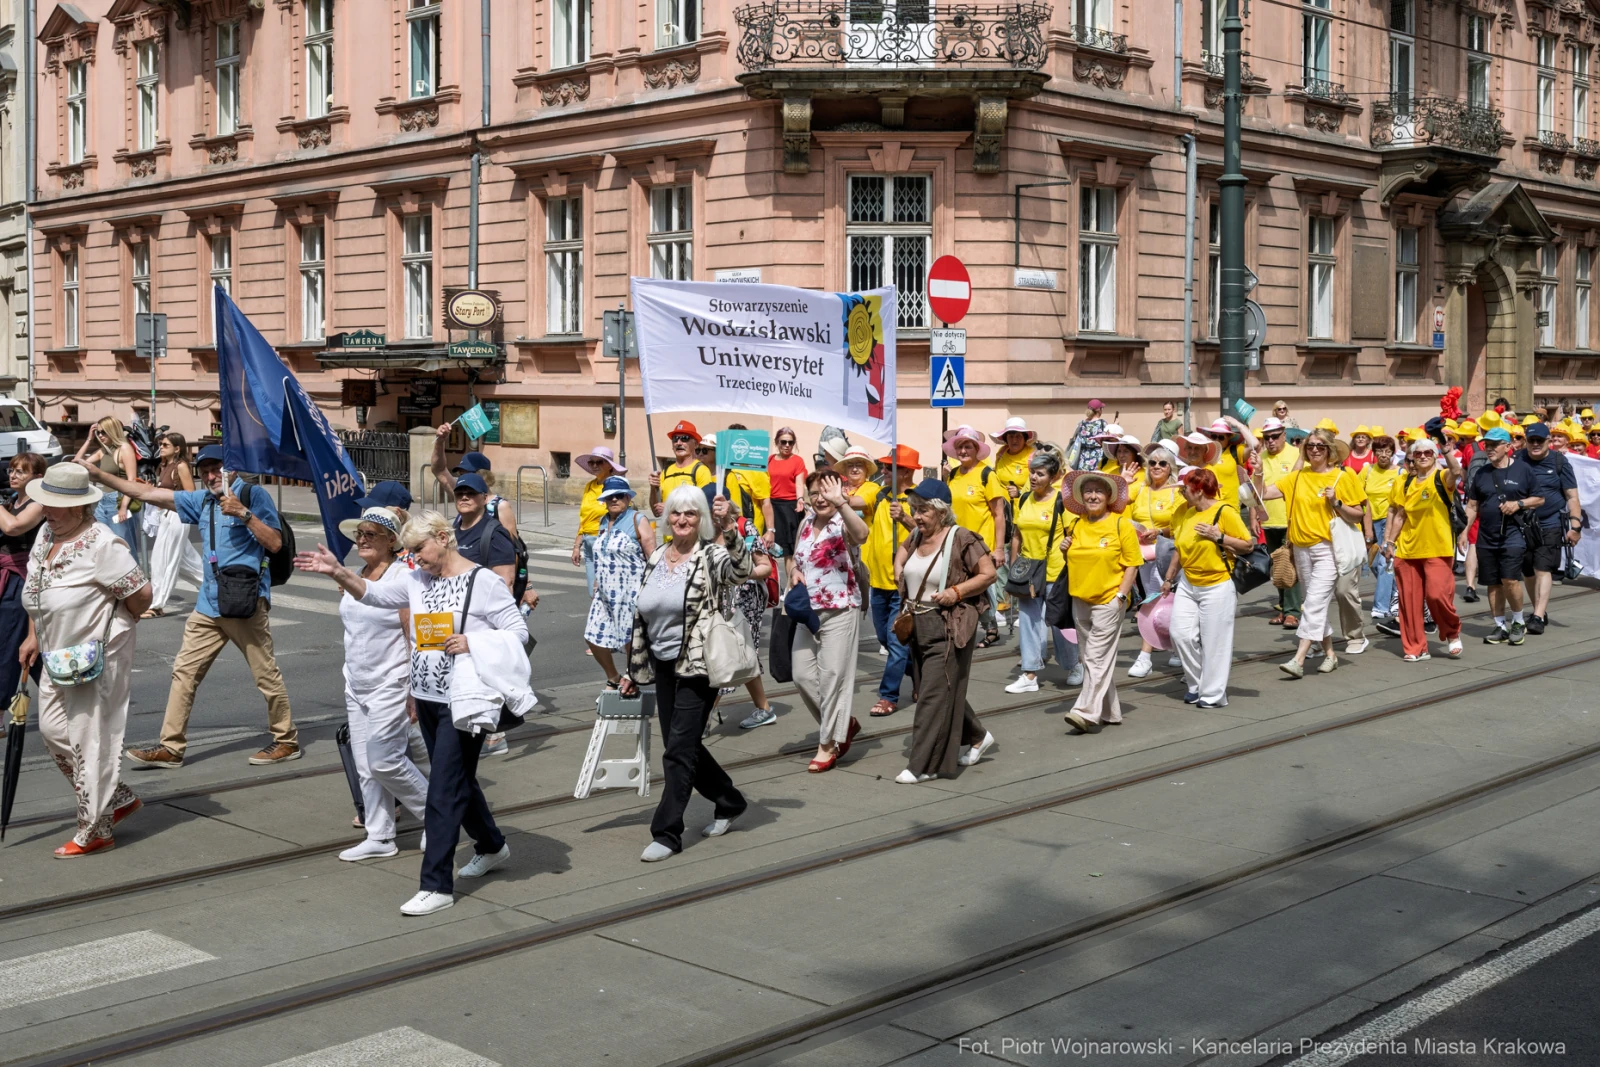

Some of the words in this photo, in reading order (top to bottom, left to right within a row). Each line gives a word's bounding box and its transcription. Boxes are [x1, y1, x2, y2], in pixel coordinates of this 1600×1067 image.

[455, 306, 472, 319] Stary
[473, 306, 485, 316] Port
[709, 298, 808, 316] Stowarzyszenie
[679, 316, 832, 345] Wodzisławski
[945, 331, 965, 340] dotyczy
[345, 337, 383, 345] TAWERNA
[452, 346, 494, 354] TAWERNA
[696, 346, 825, 379] Uniwersytet
[716, 374, 776, 396] Trzeciego
[778, 379, 813, 399] Wieku
